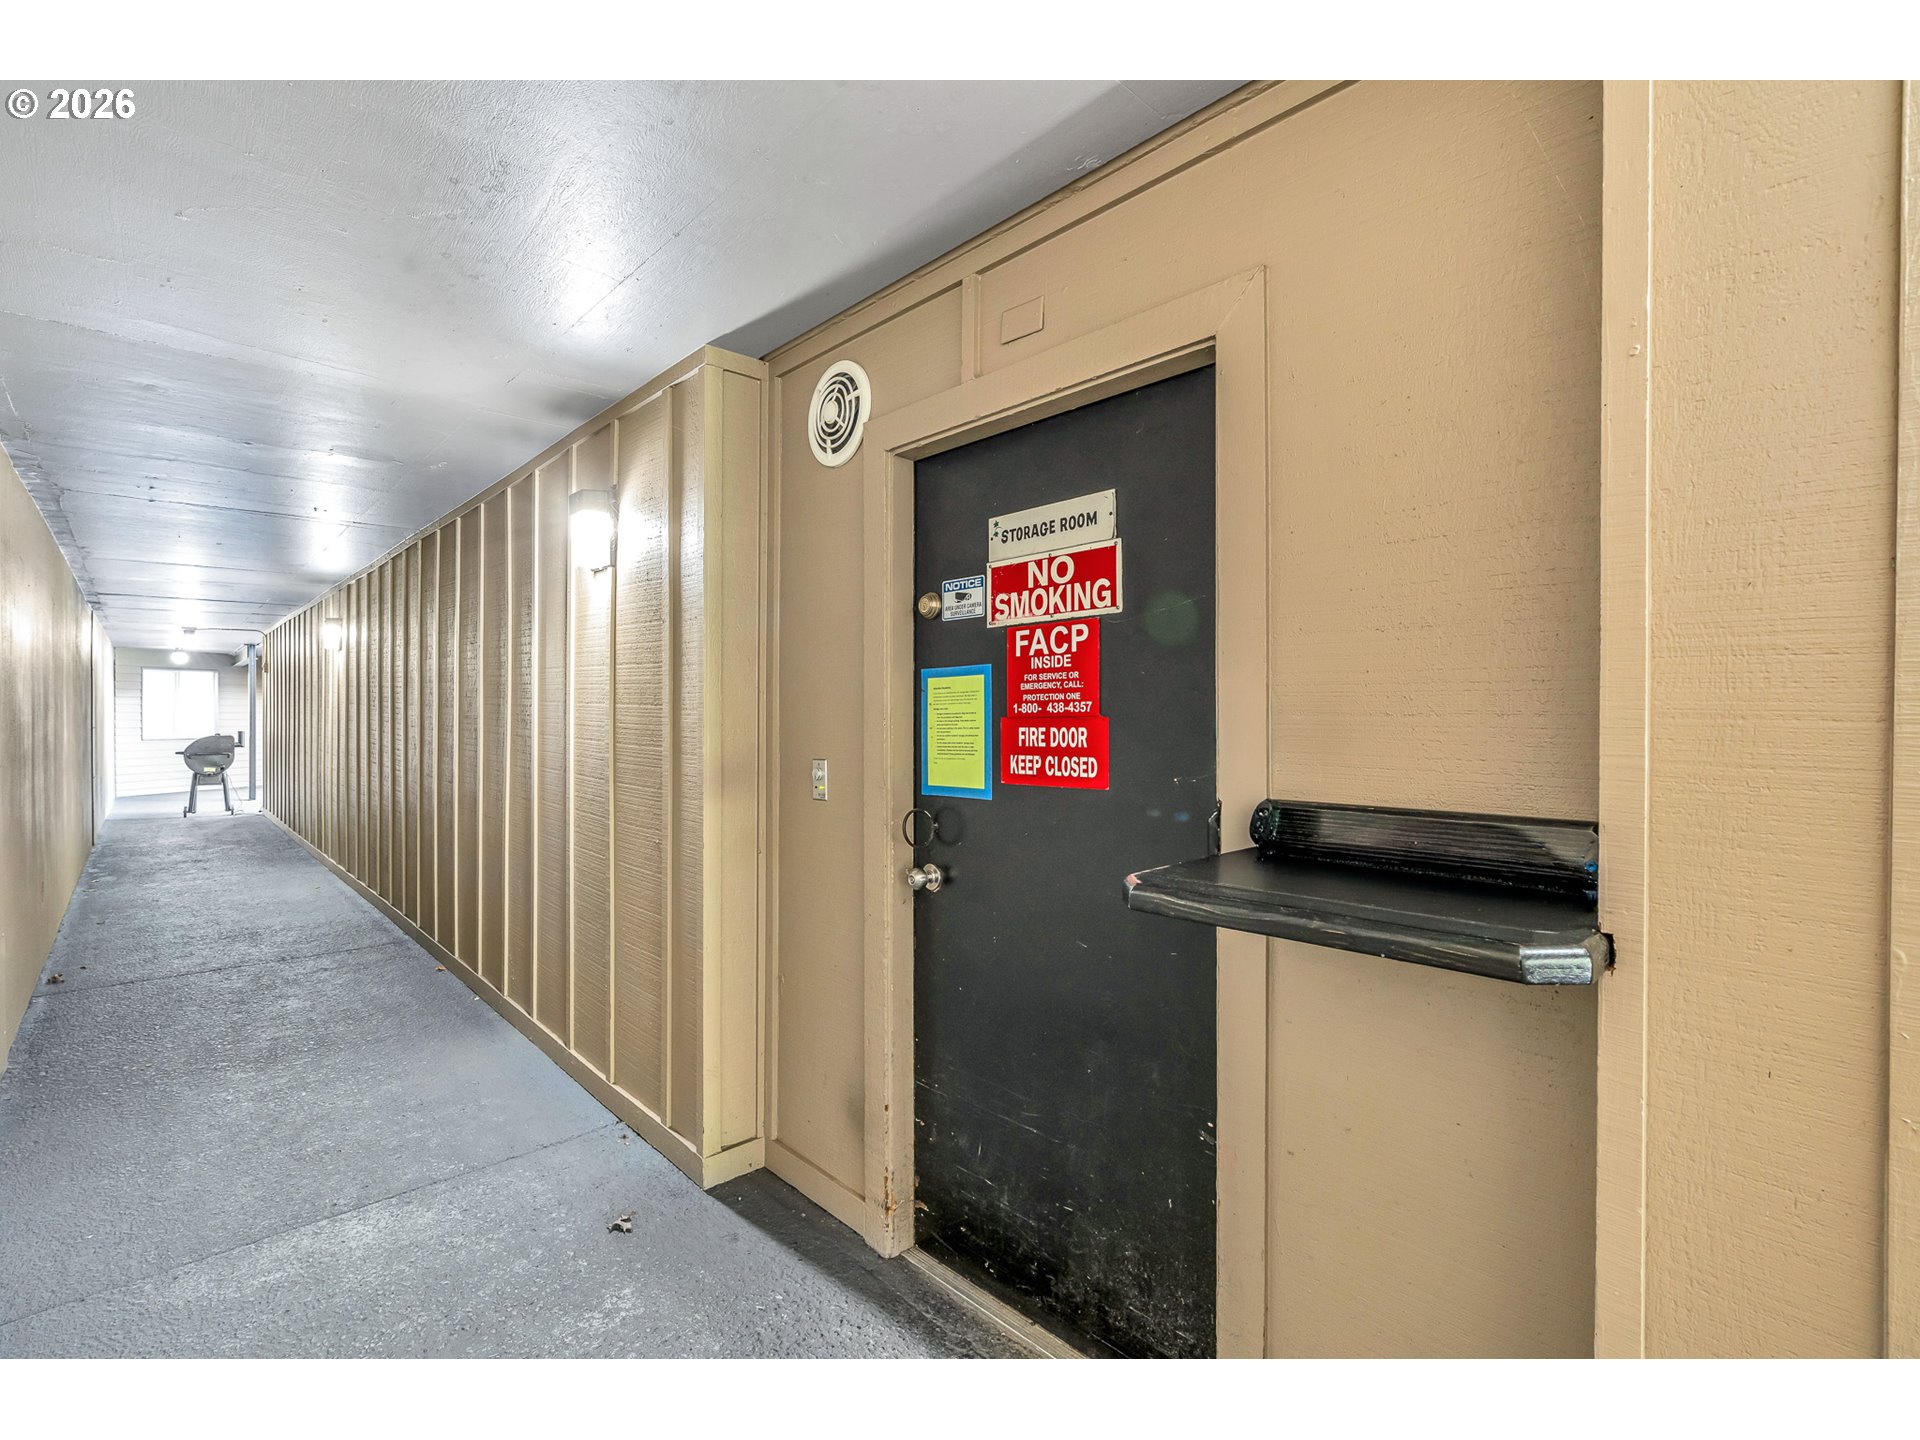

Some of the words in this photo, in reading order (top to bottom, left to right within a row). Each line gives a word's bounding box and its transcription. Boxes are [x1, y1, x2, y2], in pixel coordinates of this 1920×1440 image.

[1001, 519, 1056, 543] STORAGE
[1060, 510, 1098, 533] ROOM
[1027, 555, 1075, 589] NO
[945, 578, 982, 592] NOTICE
[954, 603, 967, 611] UNDER
[967, 601, 982, 609] CAMERA
[994, 578, 1112, 621] SMOKING
[950, 608, 976, 617] SURVEILLANCE
[1015, 623, 1089, 657] FACP
[1030, 654, 1072, 670] INSIDE
[1023, 673, 1037, 681] FOR
[1038, 671, 1067, 681] SERVICE
[1068, 671, 1079, 679] OR
[1020, 681, 1062, 690] EMERGENCY,
[1063, 680, 1084, 688] CALL:
[1022, 693, 1065, 702] PROTECTION
[1066, 692, 1081, 700] ONE
[1046, 701, 1092, 713] 438-4357
[1018, 727, 1046, 747] FIRE
[1049, 726, 1088, 748] DOOR
[1010, 754, 1042, 775] KEEP
[1045, 755, 1098, 778] CLOSED
